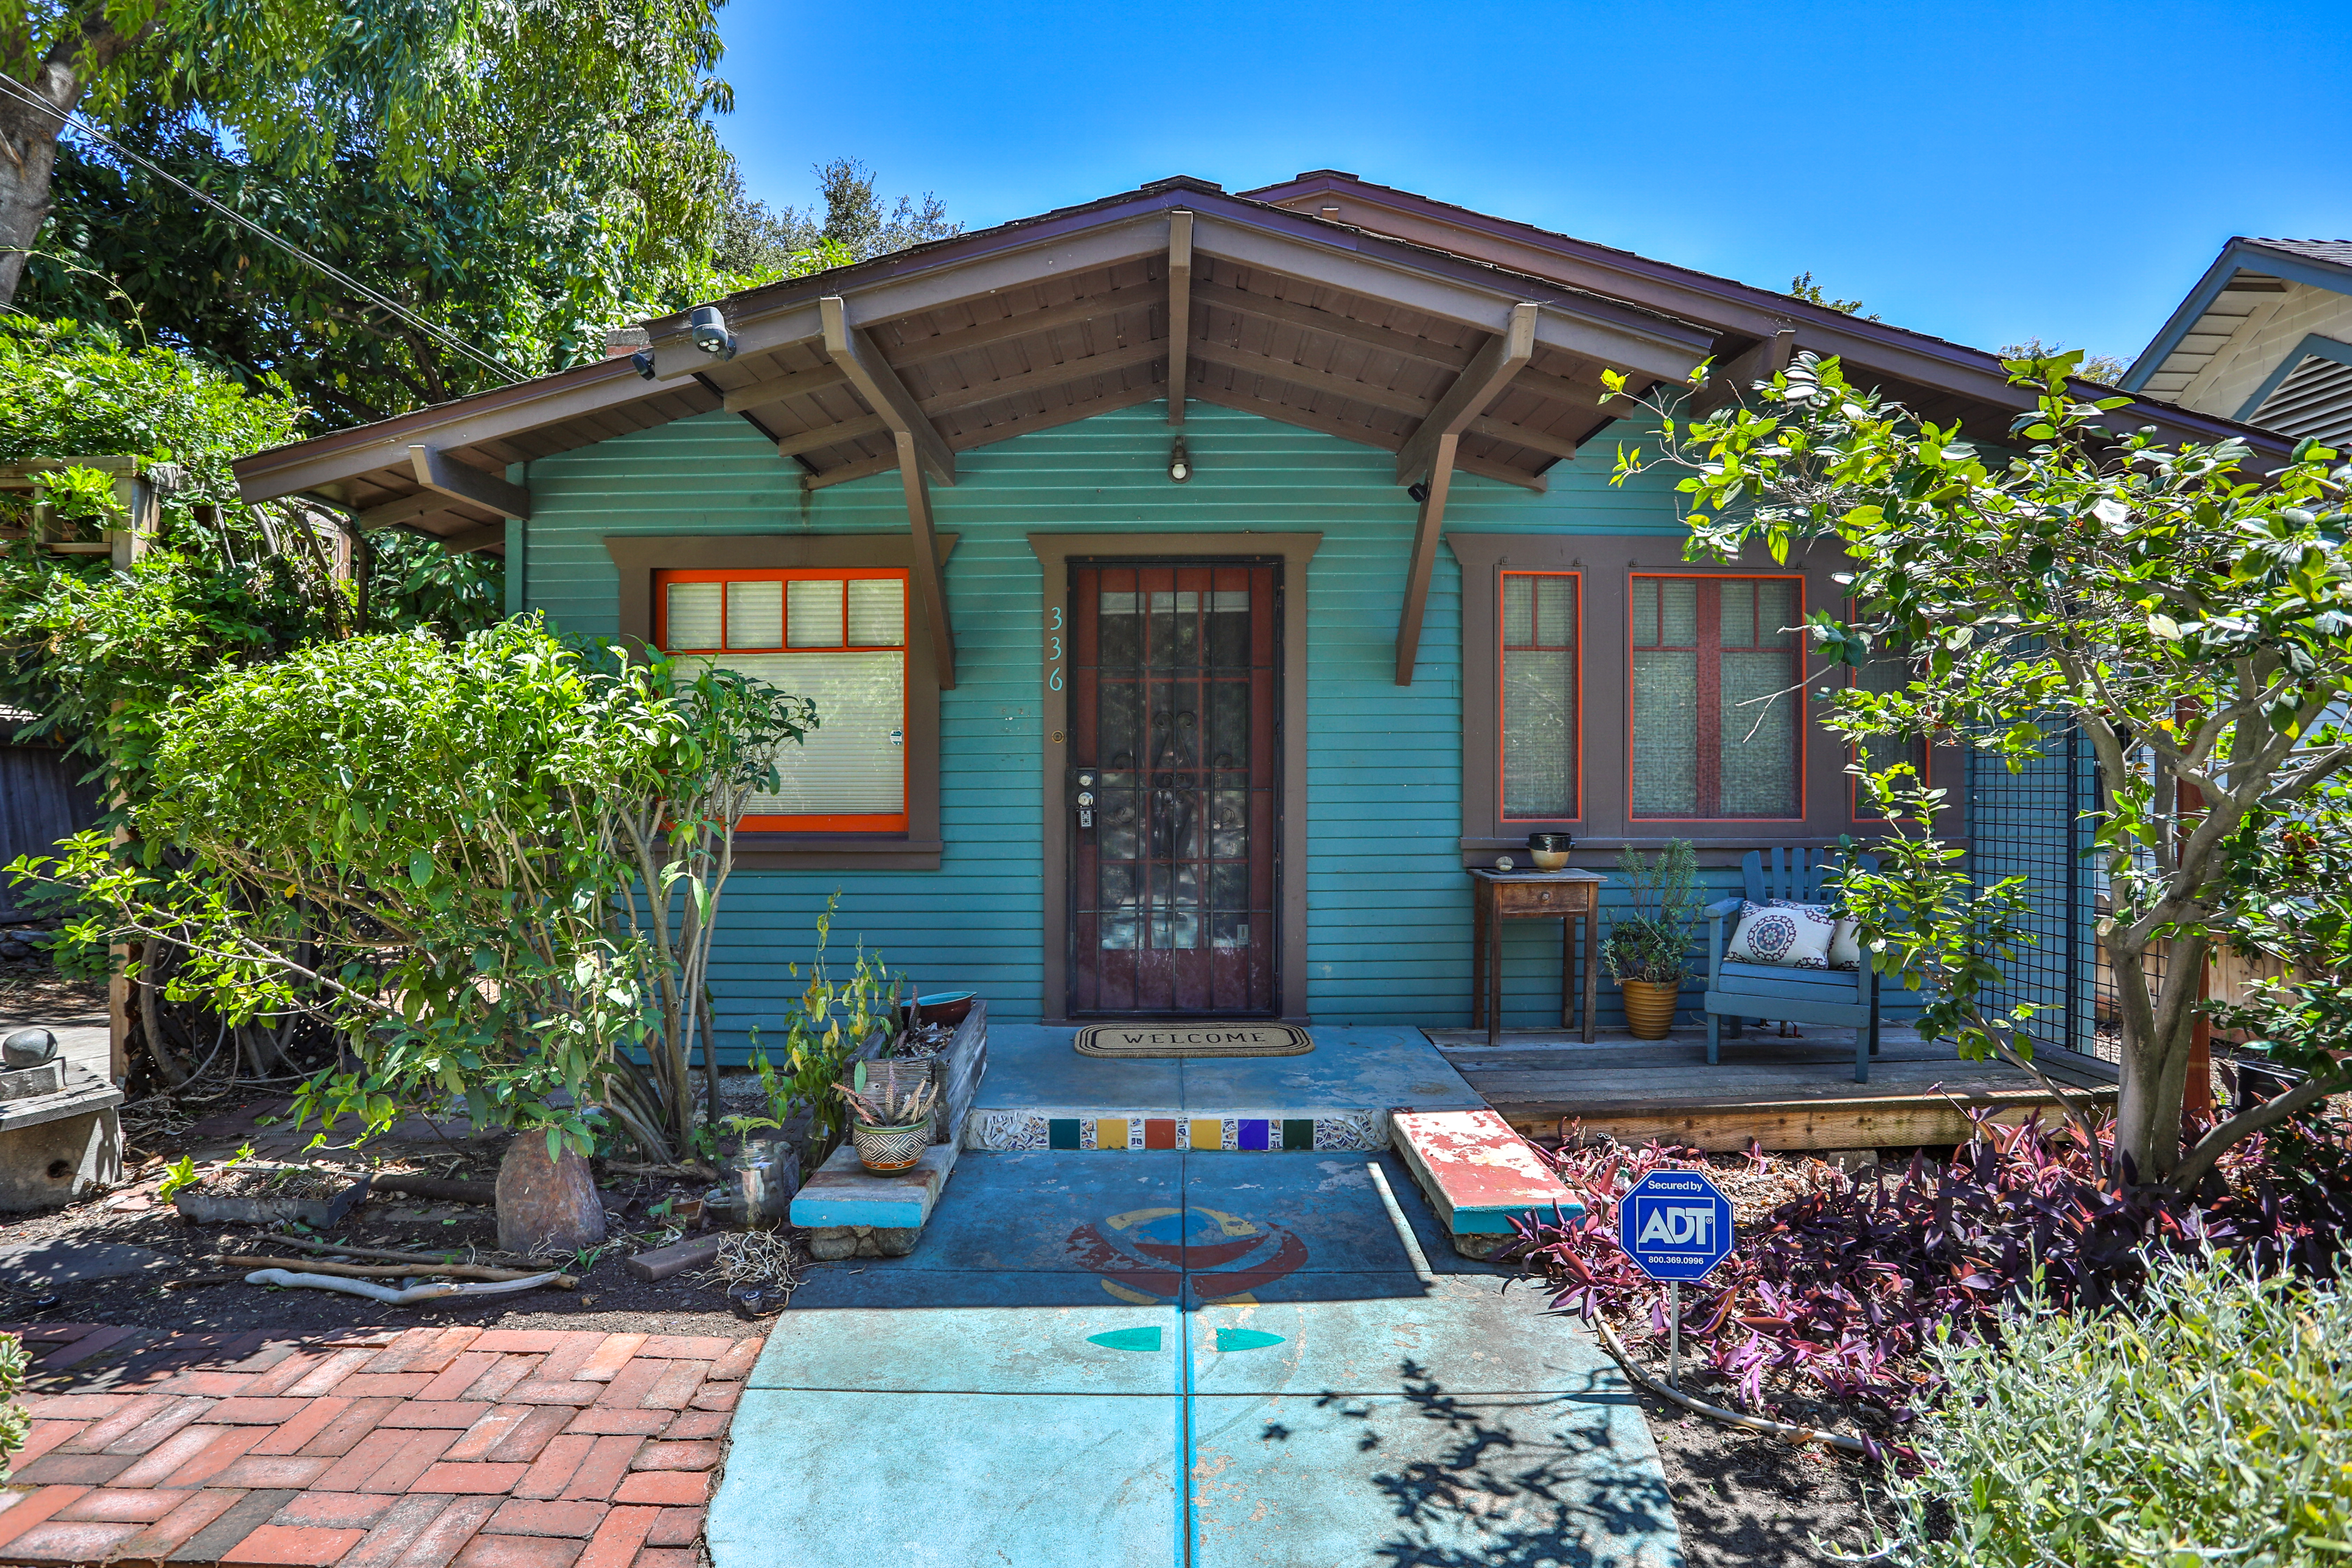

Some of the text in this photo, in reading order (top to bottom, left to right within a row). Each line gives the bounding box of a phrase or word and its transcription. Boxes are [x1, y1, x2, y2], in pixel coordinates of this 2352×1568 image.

[1049, 606, 1063, 691] 336
[1122, 1032, 1266, 1043] WELCOME
[1648, 1180, 1703, 1192] Secured by
[1638, 1206, 1715, 1245] ADT
[1648, 1256, 1704, 1265] 800.369.0996
